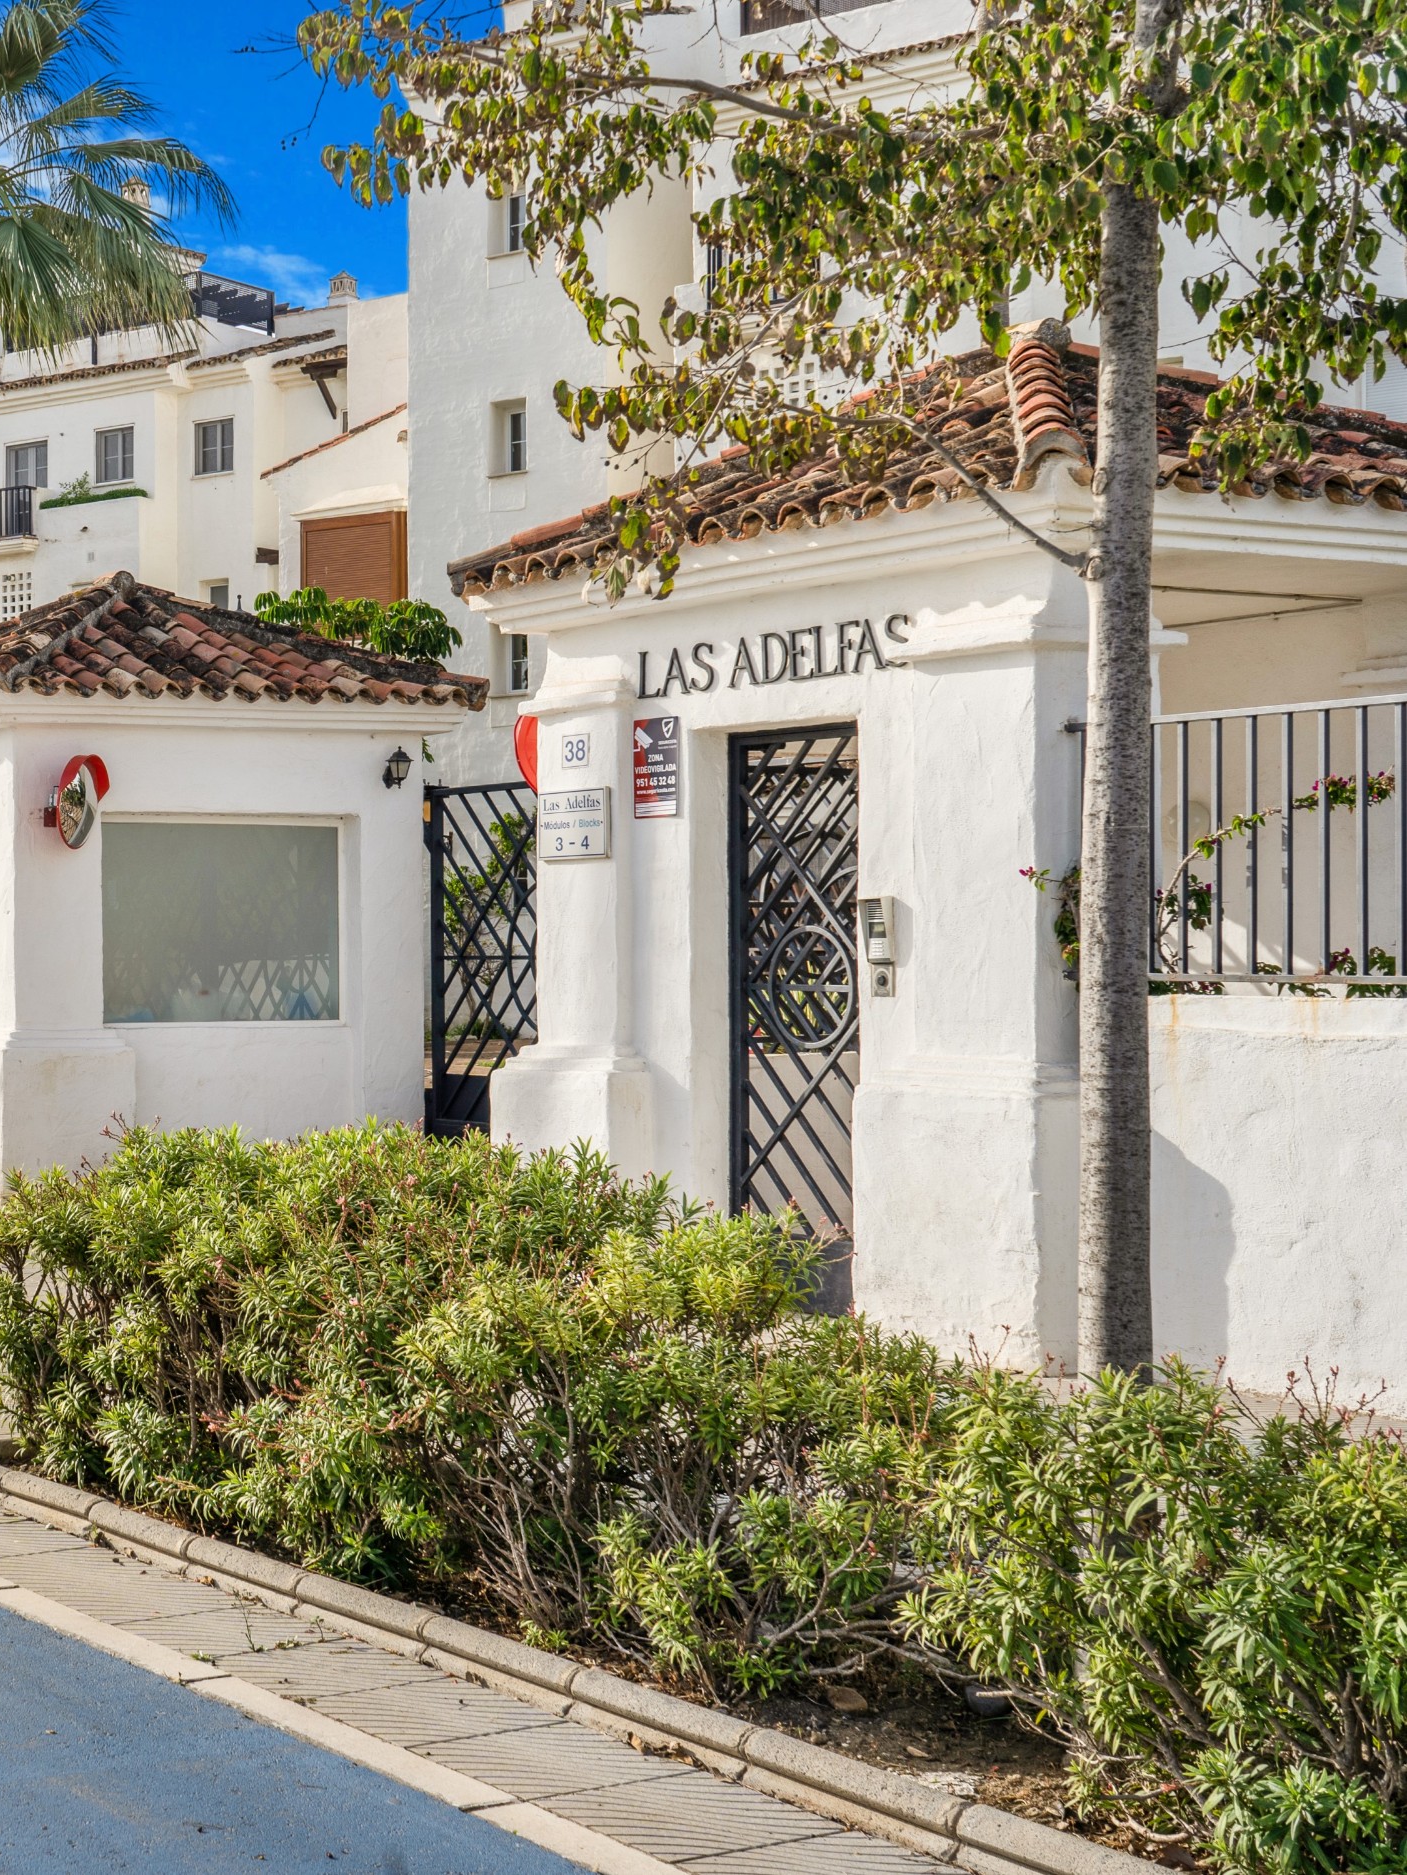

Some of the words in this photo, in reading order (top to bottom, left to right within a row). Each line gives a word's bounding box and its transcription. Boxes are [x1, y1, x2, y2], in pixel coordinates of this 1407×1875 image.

[637, 642, 714, 699] LAS
[727, 613, 910, 689] ADELFAS
[565, 739, 586, 762] 38
[647, 754, 664, 763] ZONA
[635, 763, 677, 774] VIDEOVIGILADA
[636, 778, 648, 787] 951
[649, 776, 658, 786] 45
[658, 775, 667, 785] 32
[667, 775, 676, 785] 48
[543, 799, 560, 811] Las
[565, 794, 601, 810] Adelfas
[543, 820, 570, 830] Módulos
[578, 818, 601, 828] Blocks
[555, 836, 564, 852] 3
[580, 835, 590, 850] 4
